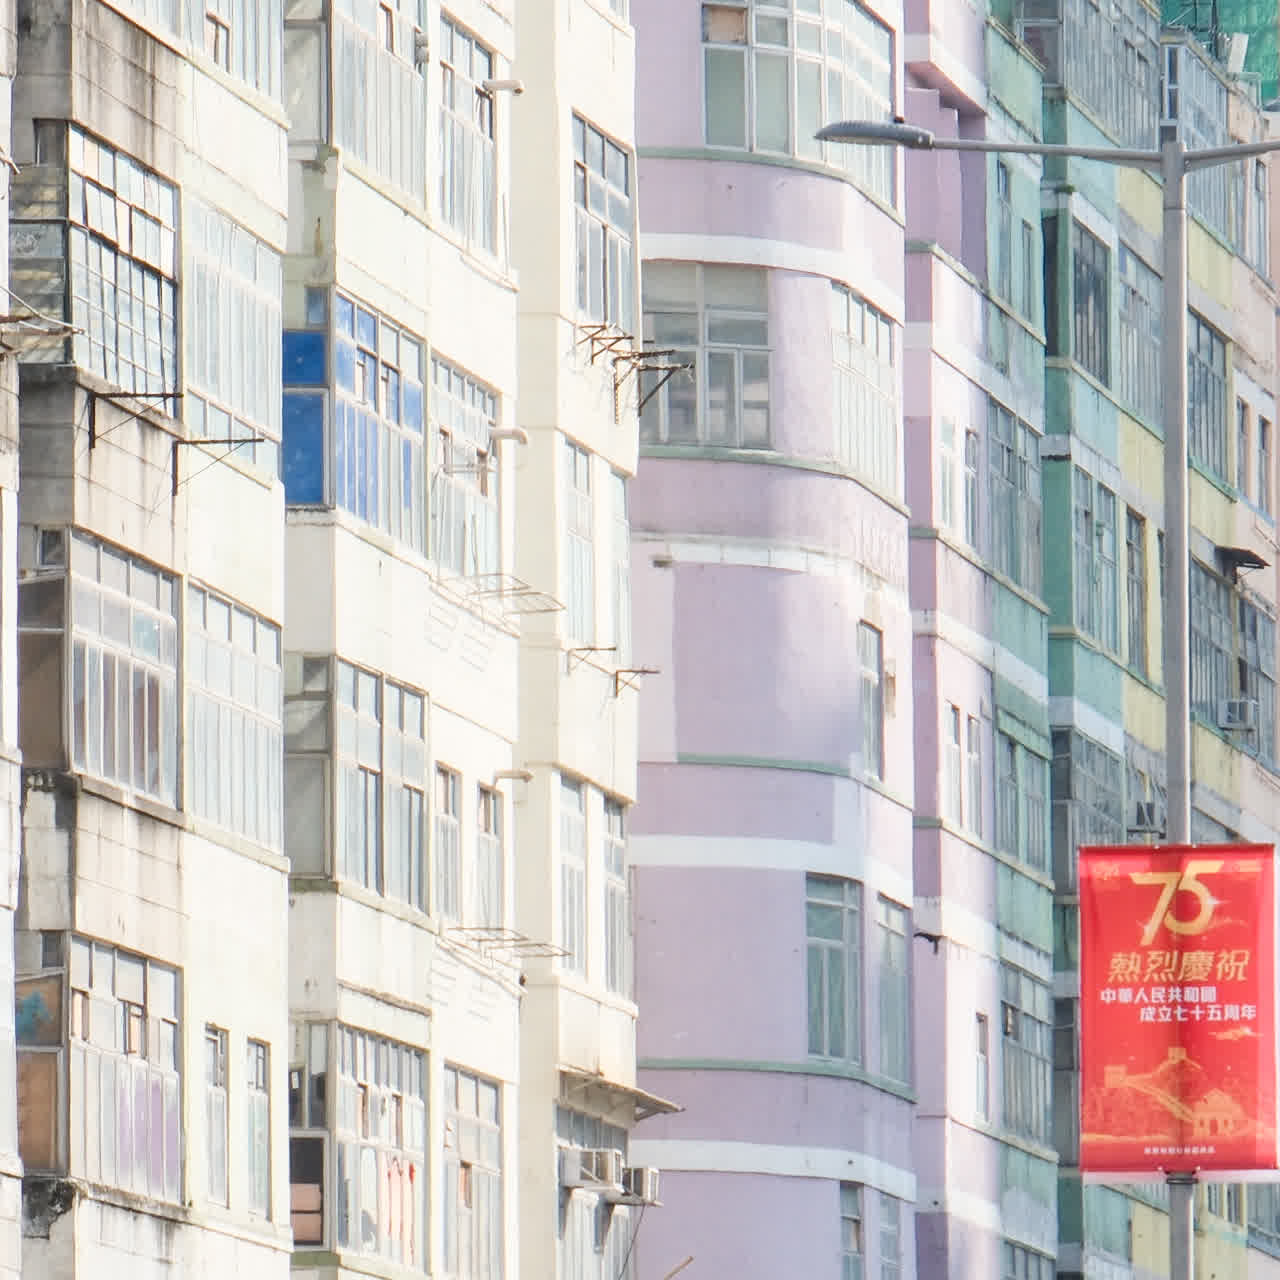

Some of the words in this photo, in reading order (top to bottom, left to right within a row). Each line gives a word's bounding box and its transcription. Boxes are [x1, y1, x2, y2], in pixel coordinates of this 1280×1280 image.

[1129, 860, 1223, 946] 75
[1107, 949, 1250, 982] 熱烈慶祝
[1140, 1004, 1257, 1022] 成立七十五周年
